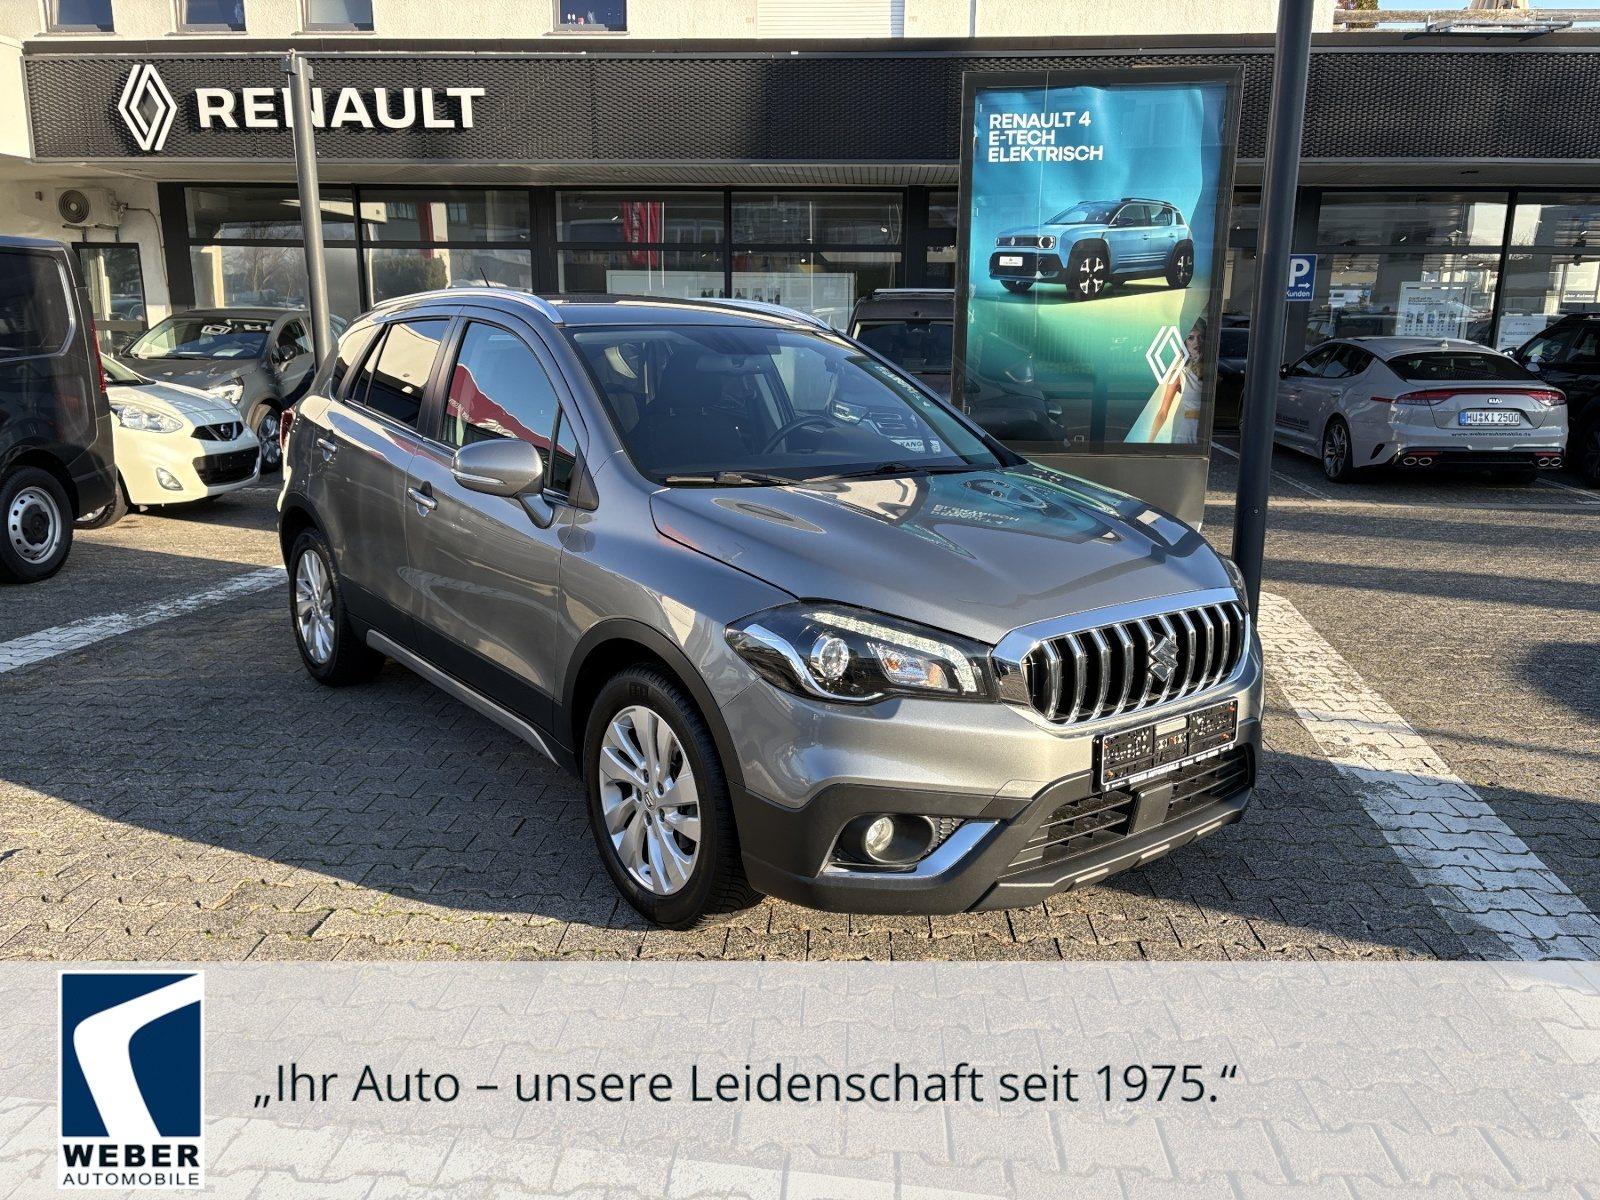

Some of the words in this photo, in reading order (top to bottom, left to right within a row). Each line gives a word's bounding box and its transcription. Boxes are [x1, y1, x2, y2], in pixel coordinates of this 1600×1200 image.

[195, 87, 485, 129] RENAULT
[989, 112, 1076, 129] RENAULT
[1078, 111, 1092, 127] 4
[988, 130, 1056, 146] E-TECH
[988, 145, 1104, 163] ELEKTRISCH
[1289, 258, 1310, 287] P
[1497, 412, 1519, 423] 2500
